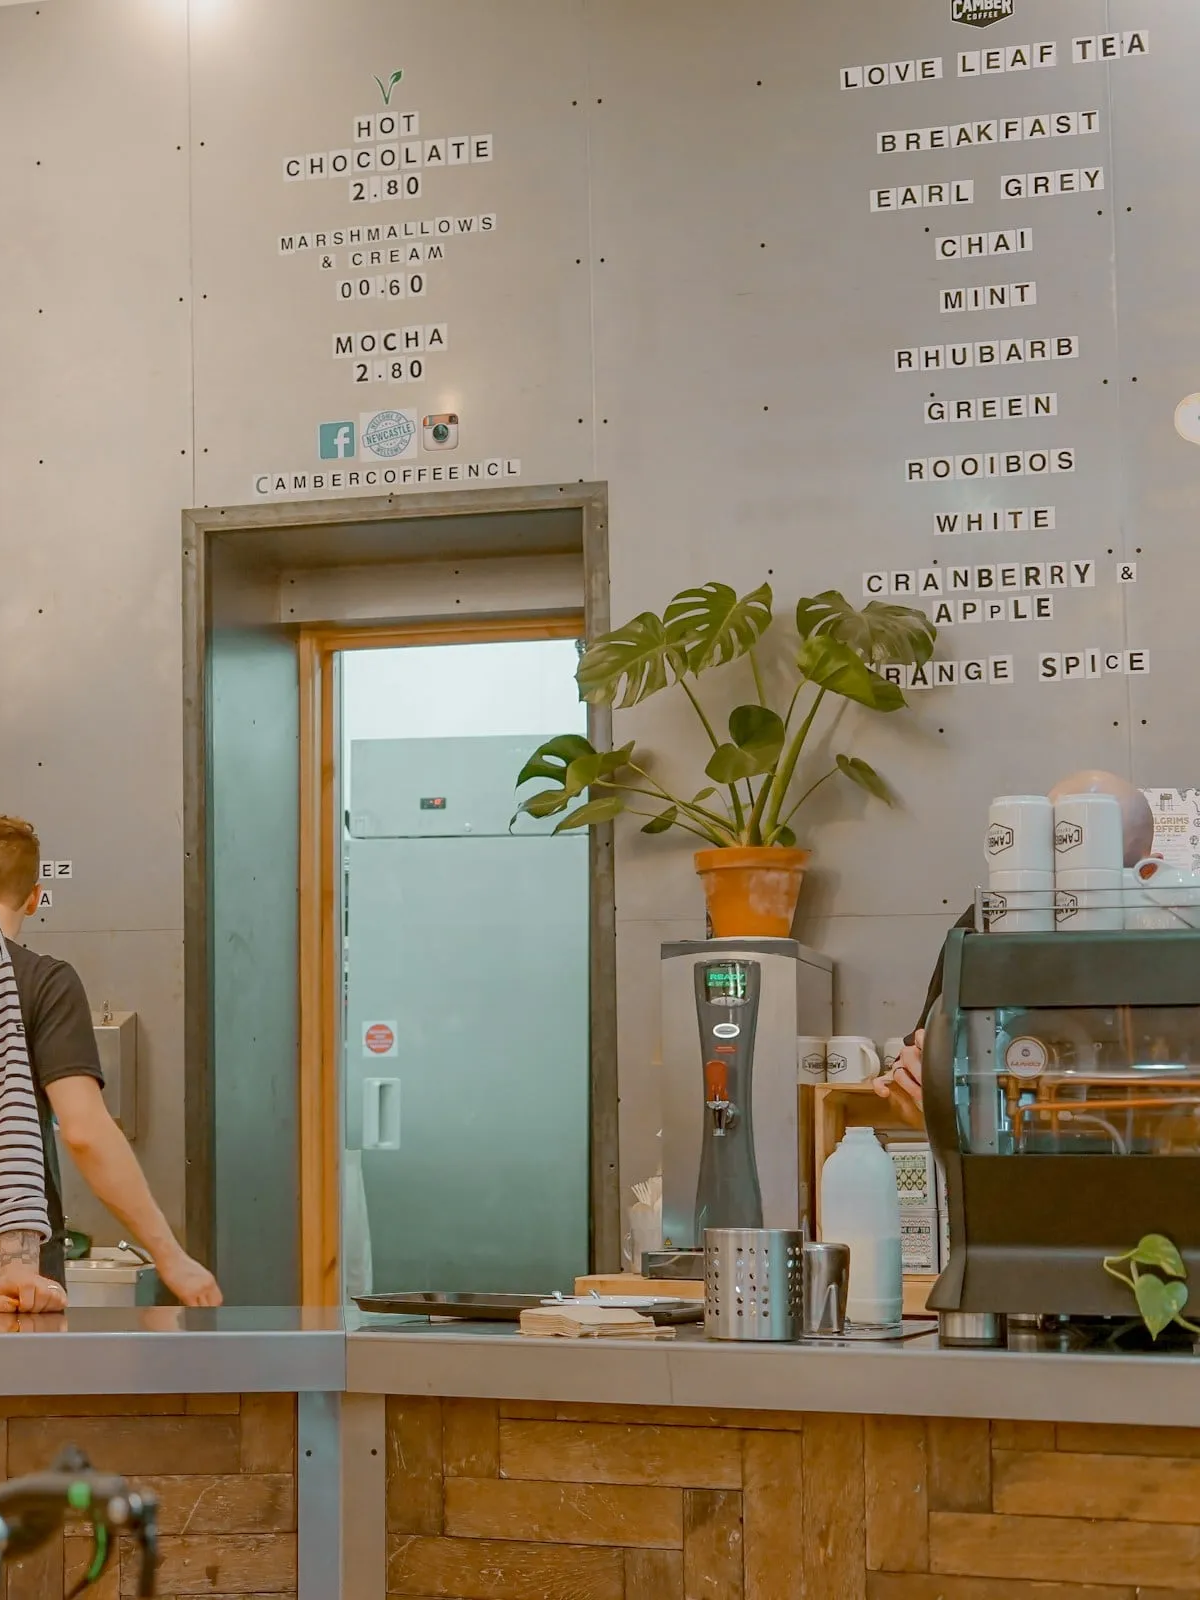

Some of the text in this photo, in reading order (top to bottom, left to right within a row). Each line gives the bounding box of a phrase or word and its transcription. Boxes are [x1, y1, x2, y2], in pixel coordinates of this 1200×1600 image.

[953, 0, 1012, 19] CAMBER
[967, 11, 998, 20] COFFEE
[844, 33, 1145, 88] LOVE LEAF TEA
[357, 114, 415, 138] HOT
[881, 111, 1097, 153] BREAKFAST
[286, 140, 488, 177] CHOCOLATE
[353, 176, 419, 201] 2.80
[877, 169, 1100, 208] EARL GREY
[281, 217, 493, 250] MARSHMALLOWS
[941, 231, 1025, 257] CHAI
[322, 245, 443, 268] & CREAM
[341, 275, 423, 298] 00.60
[944, 284, 1029, 310] MINT
[335, 328, 444, 355] MOCHA
[898, 338, 1073, 369] RHUBARB
[356, 360, 422, 382] 2.80
[928, 396, 1051, 421] GREEN
[366, 423, 411, 445] NEWCASTLE
[256, 461, 517, 494] CAMBERCOFFEENCL
[908, 451, 1073, 481] ROOIBOS
[937, 510, 1049, 533] WHITE
[866, 563, 1134, 593] CRANBERRY &
[935, 597, 1051, 623] APPLE
[884, 653, 1145, 686] RANGE SPICE
[1154, 817, 1189, 825] LGRIMS
[1154, 825, 1187, 833] OFFEE
[42, 864, 71, 877] EZ
